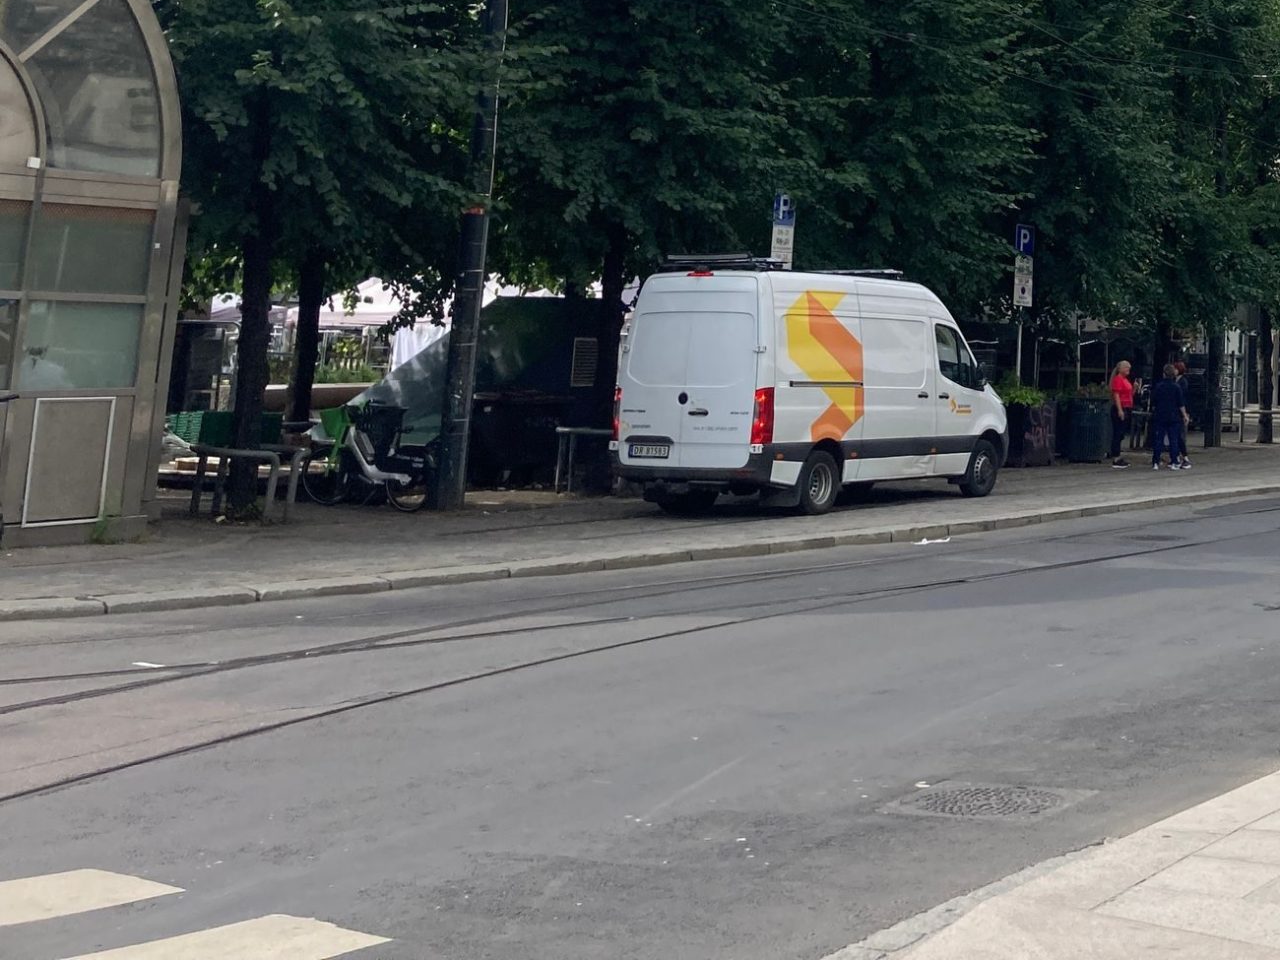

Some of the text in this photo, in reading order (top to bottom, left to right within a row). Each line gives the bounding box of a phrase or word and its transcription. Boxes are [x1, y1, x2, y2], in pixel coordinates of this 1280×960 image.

[780, 195, 790, 220] P
[1020, 229, 1030, 252] P
[633, 446, 644, 455] DR
